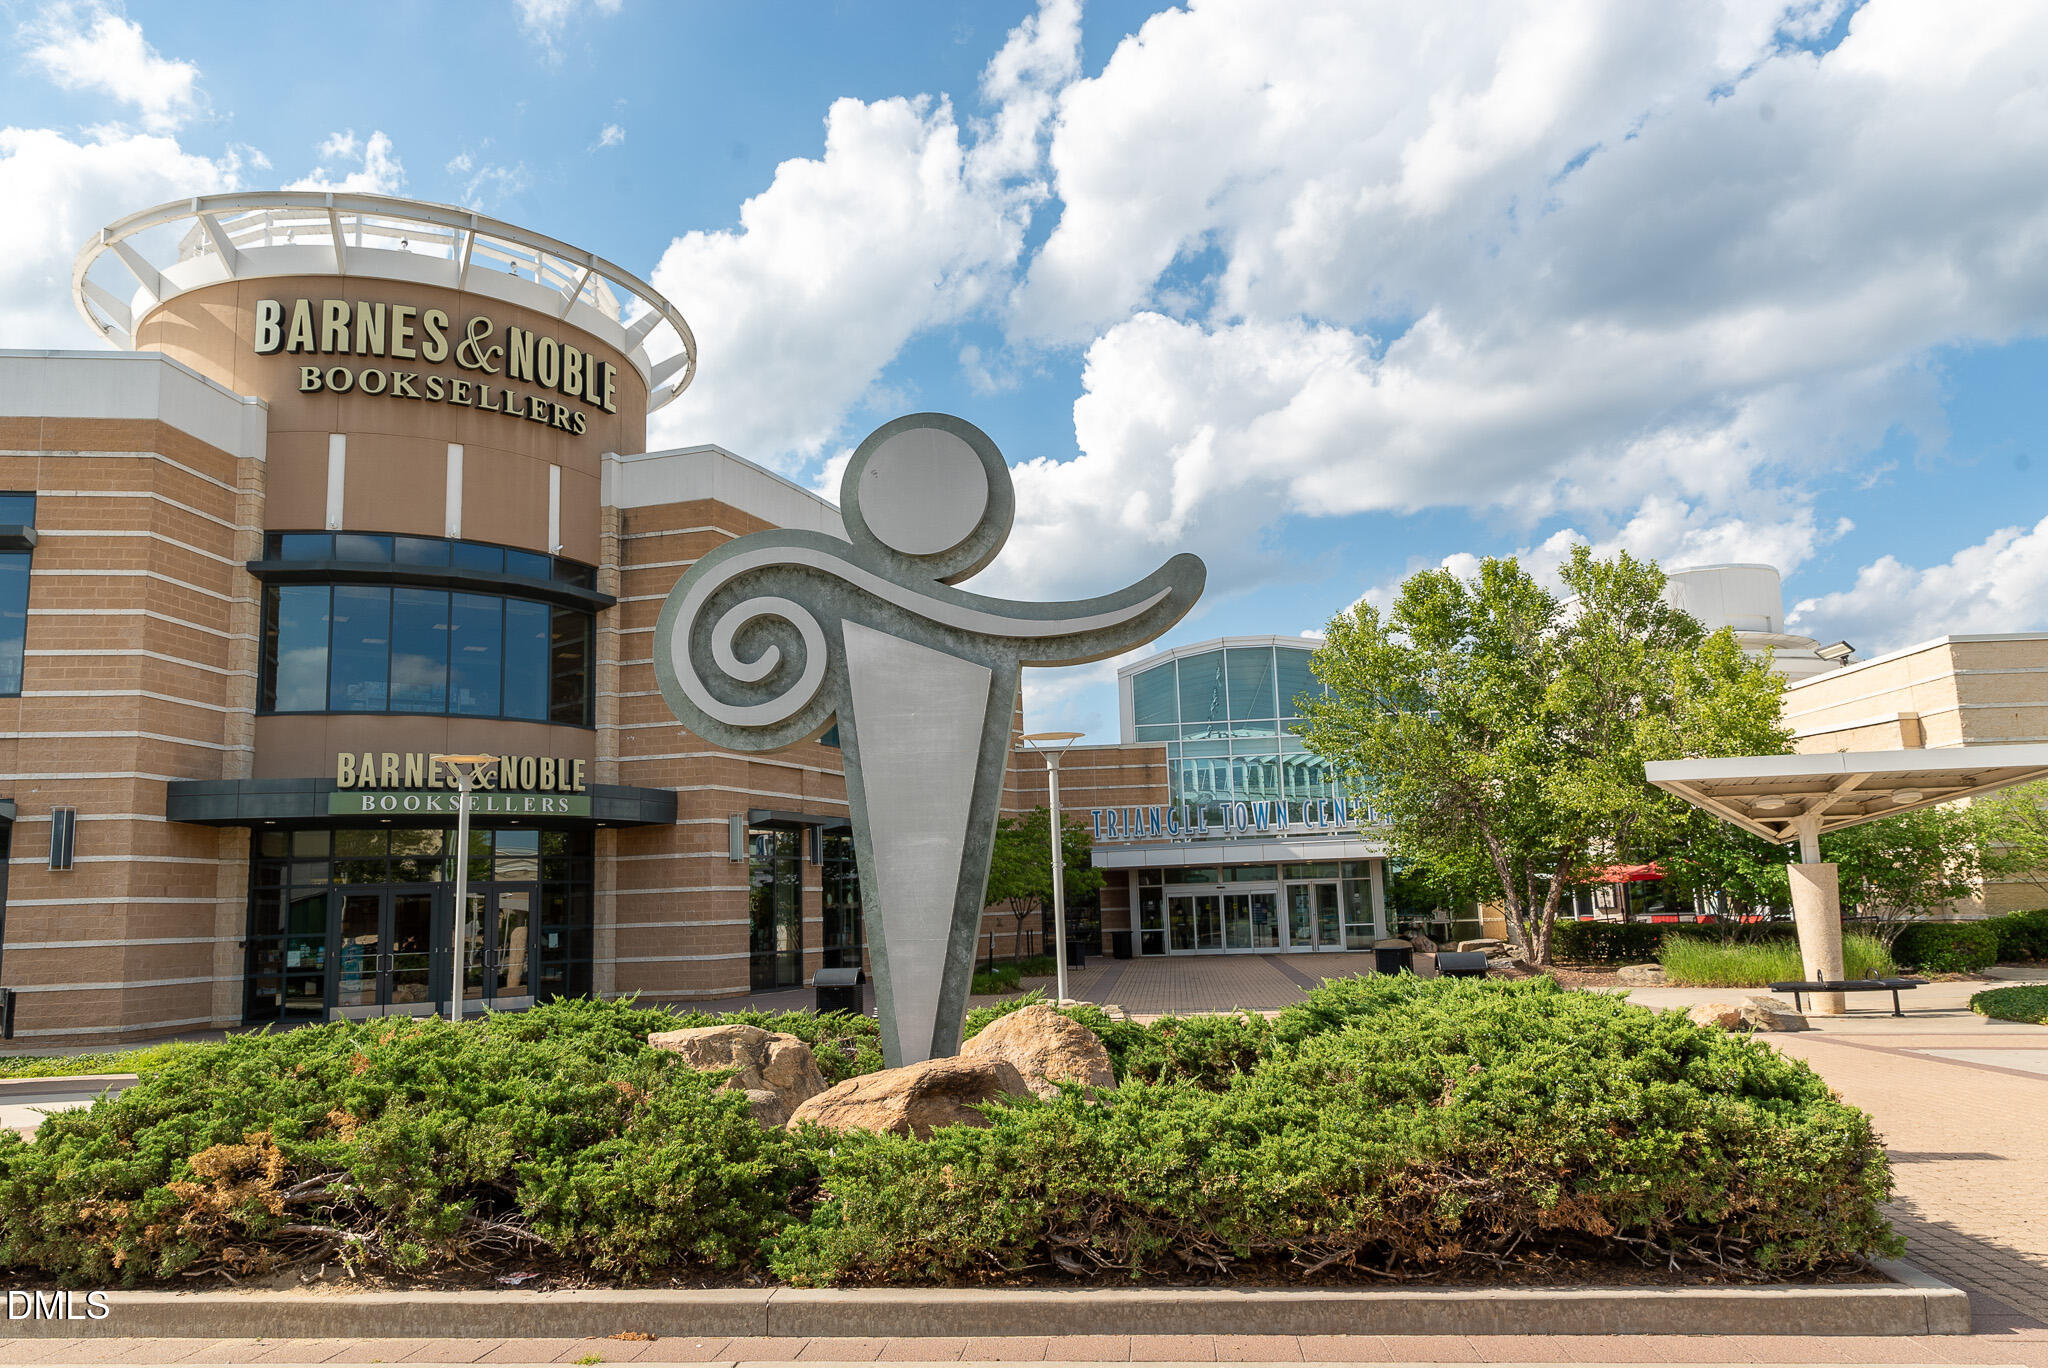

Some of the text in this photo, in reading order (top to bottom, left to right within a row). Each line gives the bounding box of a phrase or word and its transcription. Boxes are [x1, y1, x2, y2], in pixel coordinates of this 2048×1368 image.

[254, 298, 617, 415] BARNES & NOBLE
[298, 365, 587, 436] BOOKSELLERS
[500, 755, 586, 792] NOBLE
[360, 794, 569, 813] BOOKSELLERS
[1091, 803, 1209, 839] TRIANGLE
[1220, 799, 1290, 834] TOWN
